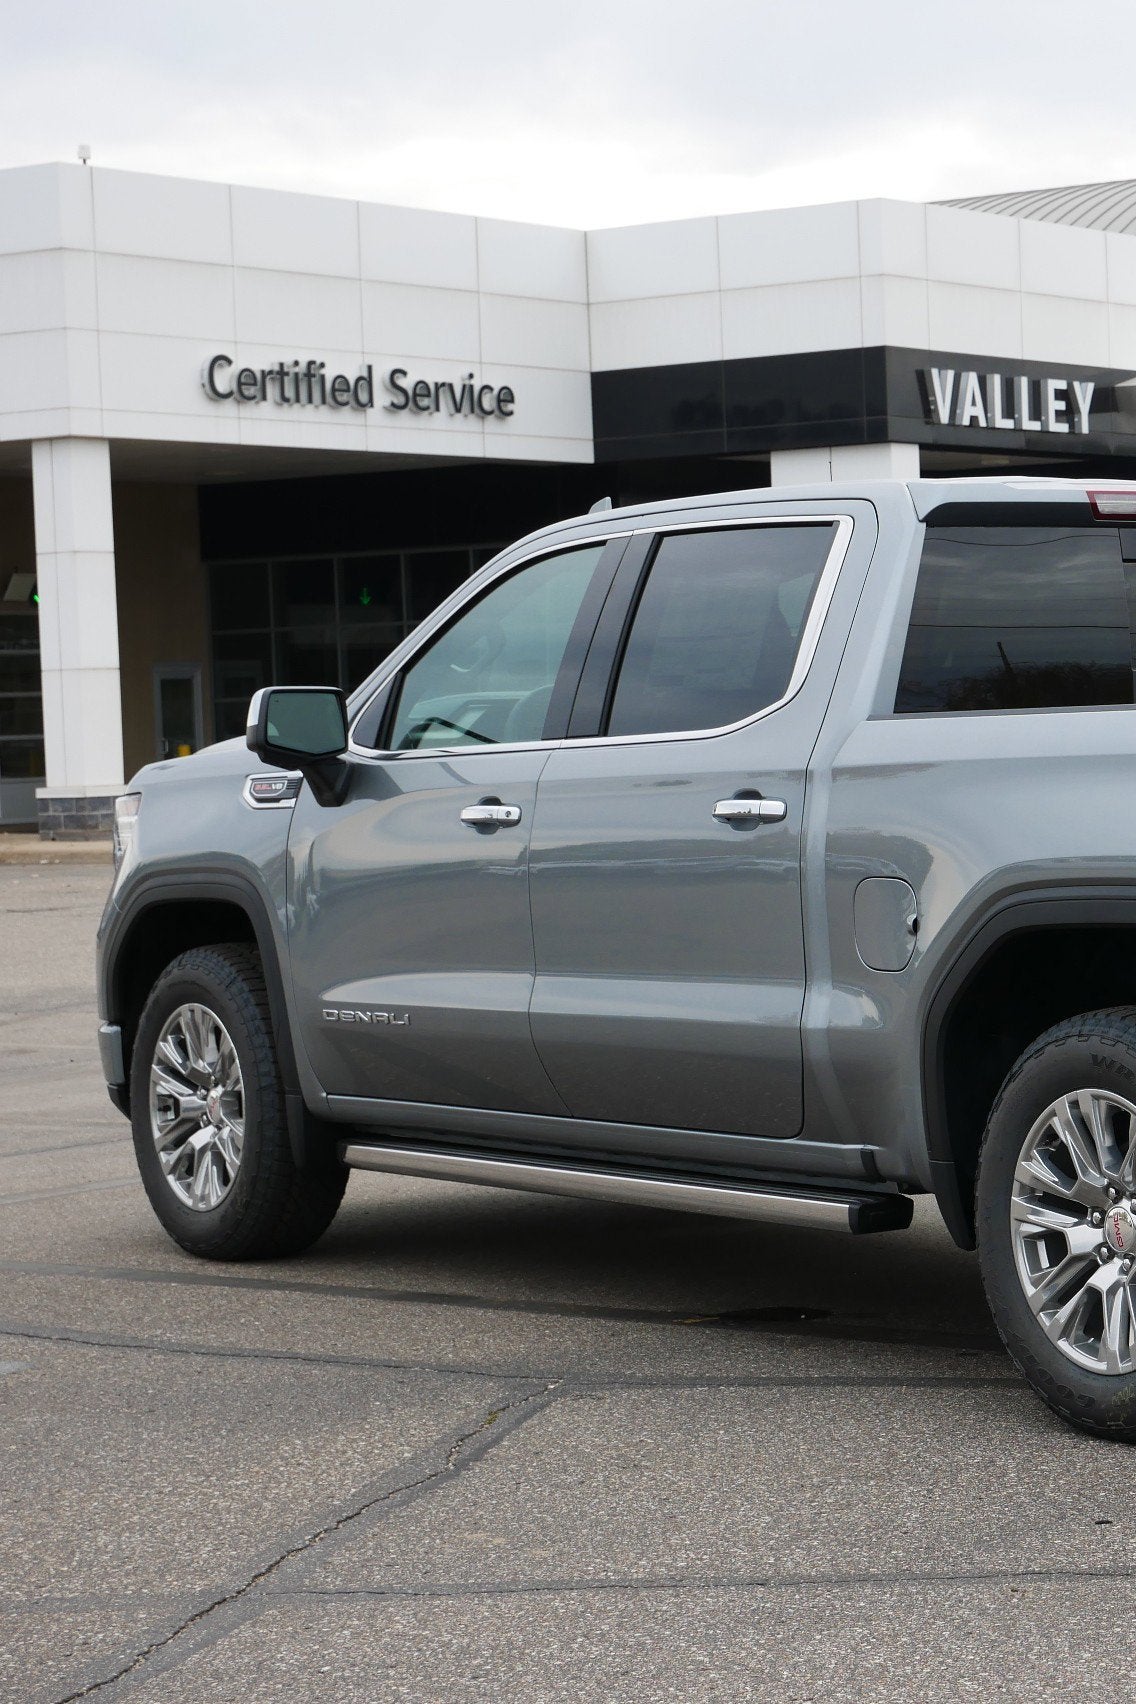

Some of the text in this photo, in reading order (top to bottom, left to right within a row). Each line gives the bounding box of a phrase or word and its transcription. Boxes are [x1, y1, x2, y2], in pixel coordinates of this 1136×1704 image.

[202, 353, 516, 418] Certified Service
[930, 367, 1095, 435] VALLEY
[322, 1008, 411, 1026] DENALI
